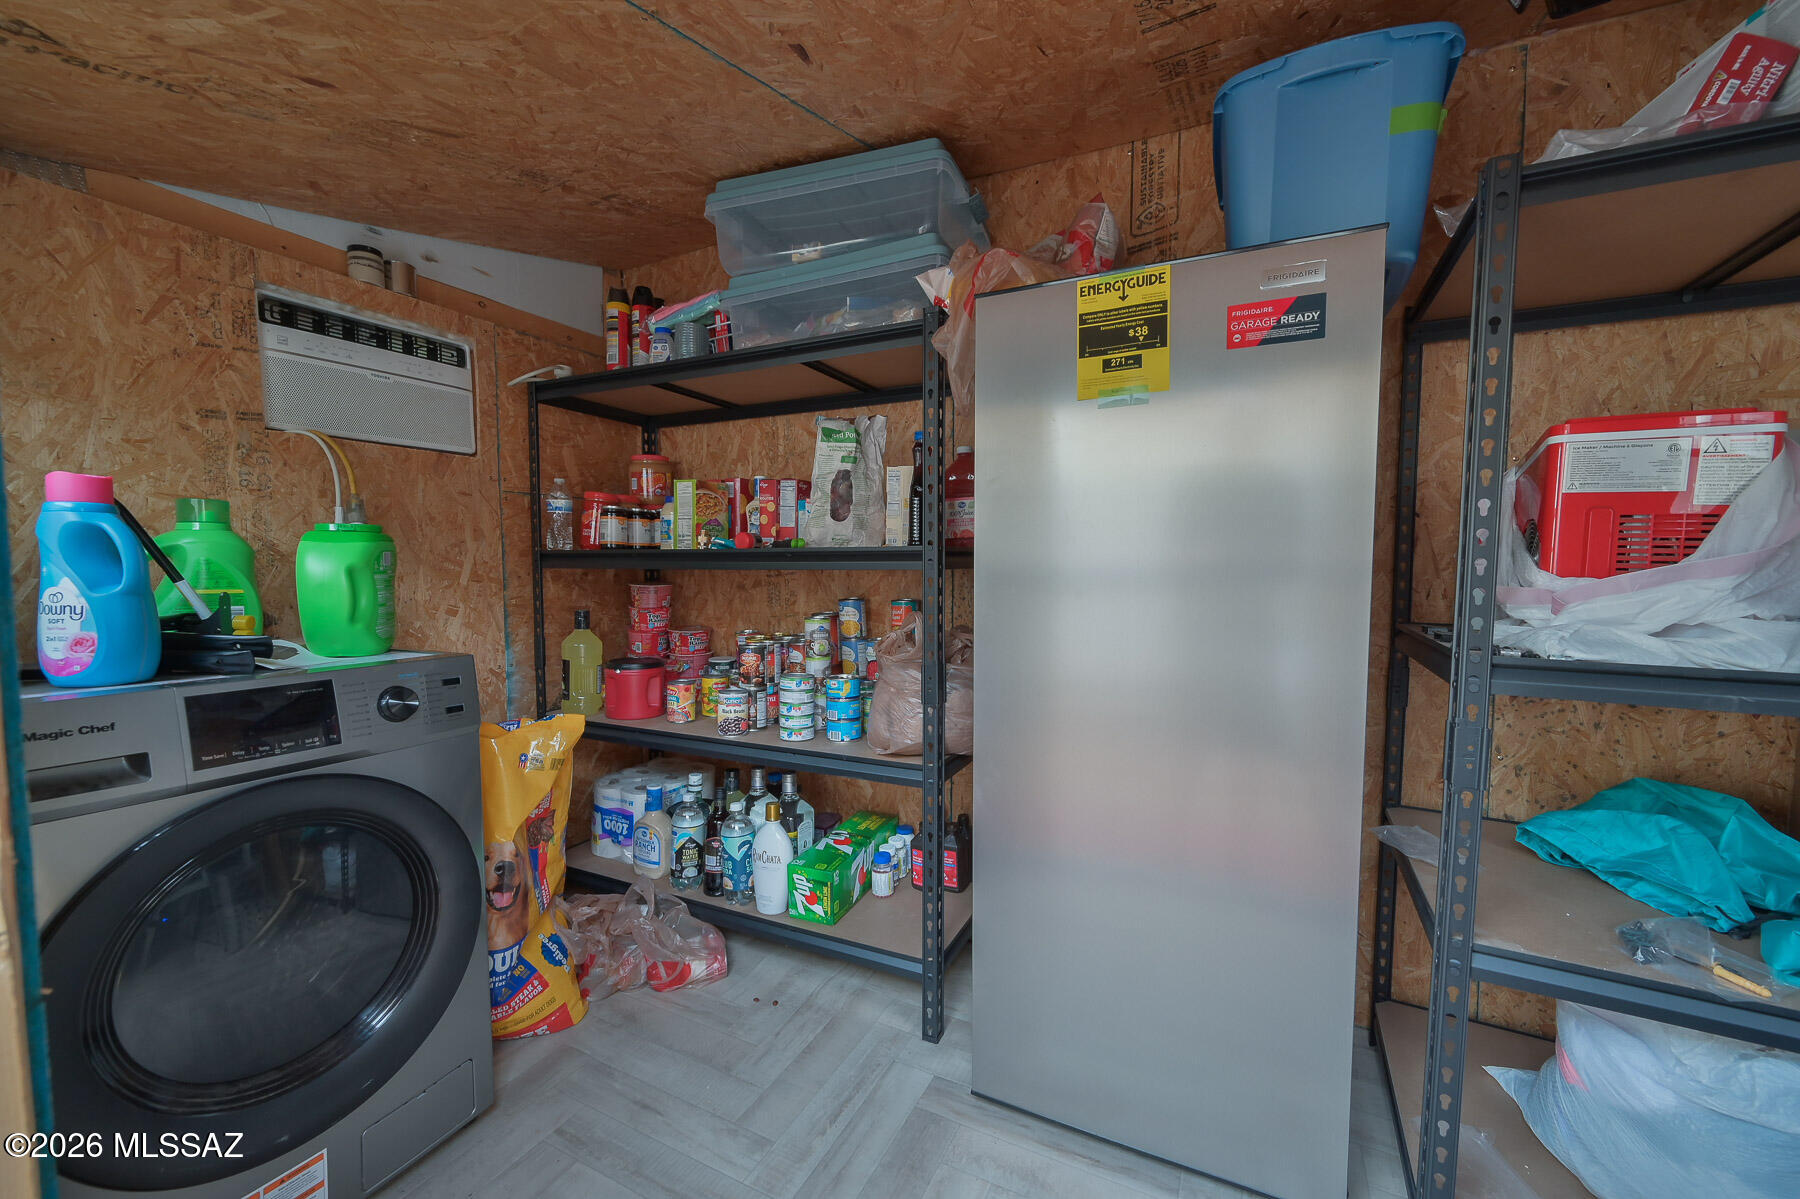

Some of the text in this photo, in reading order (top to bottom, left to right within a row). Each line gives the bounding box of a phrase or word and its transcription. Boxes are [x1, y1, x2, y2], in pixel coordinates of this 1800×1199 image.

[1139, 138, 1148, 206] SUSTAINABLE
[1079, 271, 1167, 299] ENERGYGUIDE
[1267, 268, 1320, 282] FRIGIDAIRE
[1230, 311, 1320, 331] GARAGE READY
[1232, 306, 1273, 317] FRIGIDAIRE
[1128, 325, 1149, 337] $38
[1111, 357, 1125, 367] 271
[39, 601, 84, 621] Downy
[23, 722, 116, 742] Magic Chef
[603, 819, 629, 835] 1000
[682, 848, 699, 856] TONIC
[537, 933, 571, 974] Pedigree
[510, 984, 534, 1007] STEAK
[515, 985, 543, 1011] FLAVOR
